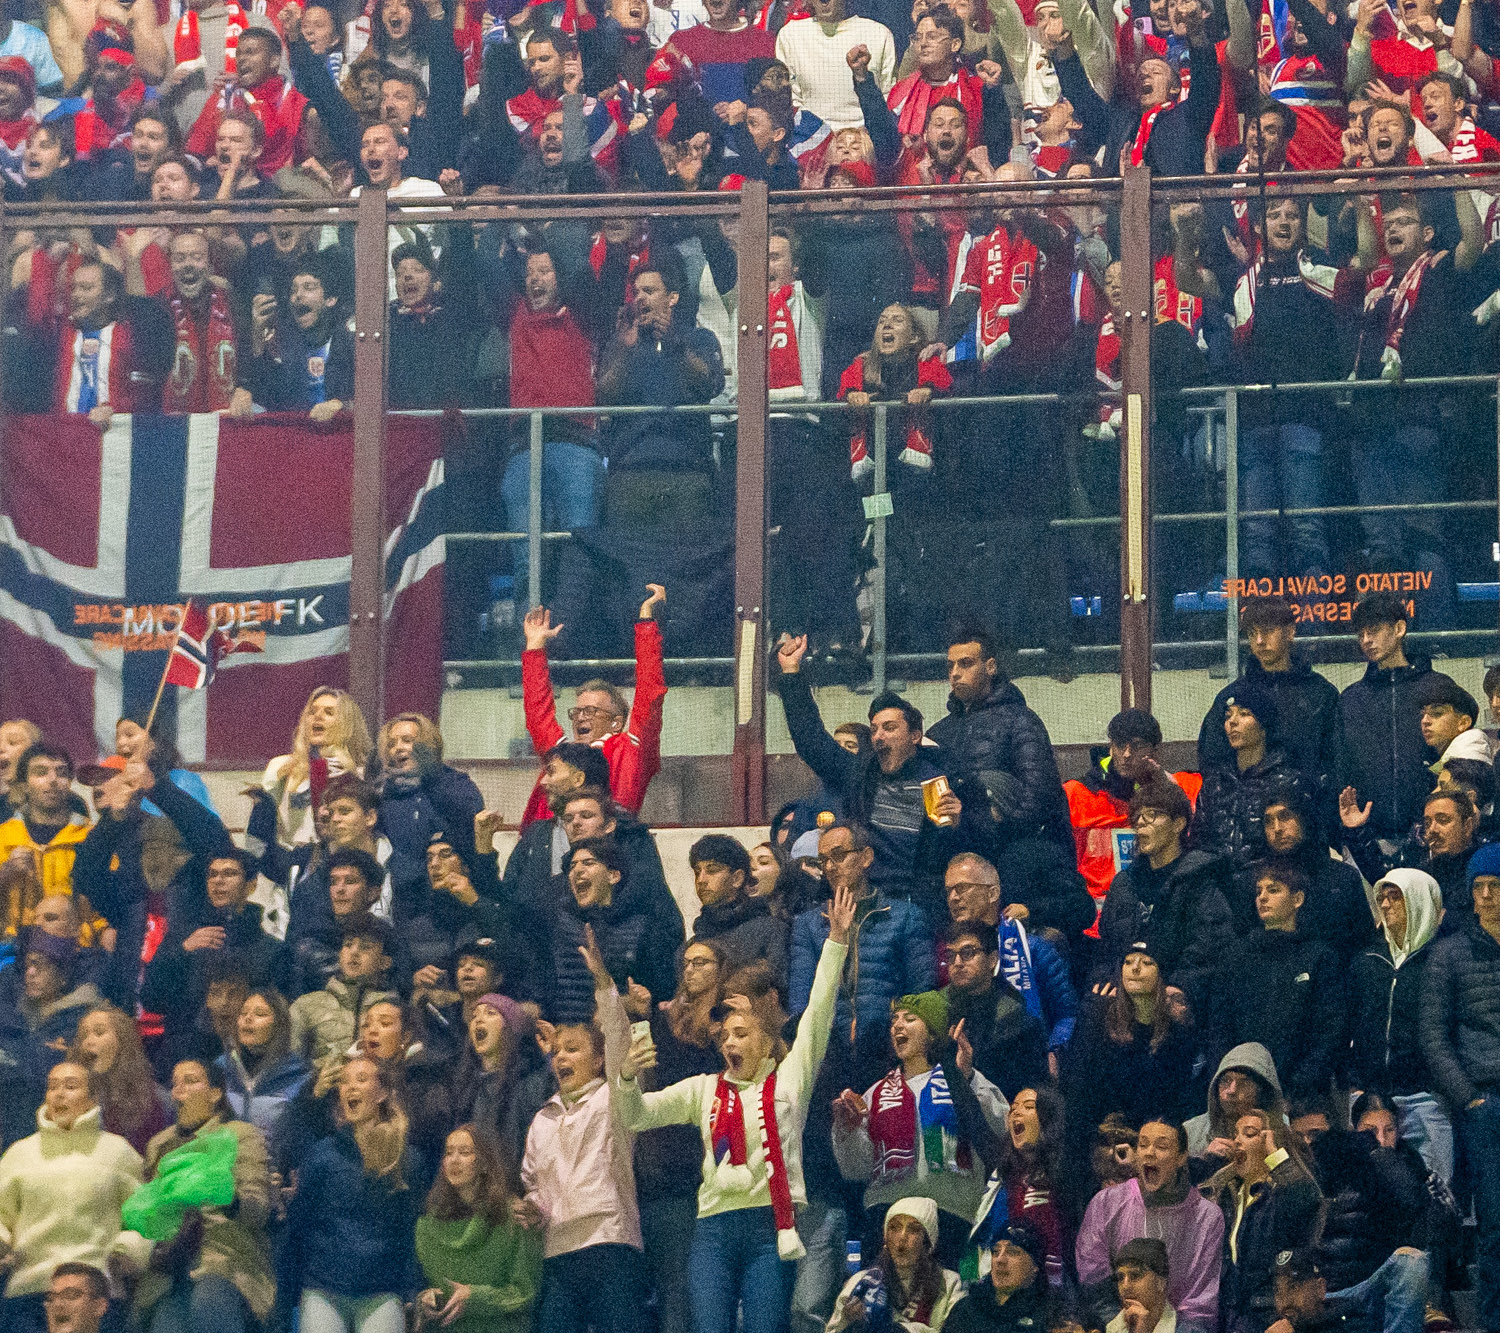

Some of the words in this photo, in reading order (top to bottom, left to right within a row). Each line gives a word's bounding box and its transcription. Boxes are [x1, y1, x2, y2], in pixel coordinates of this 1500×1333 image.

[122, 599, 261, 635] MODE
[273, 595, 324, 625] FK
[1003, 936, 1023, 991] ALIA
